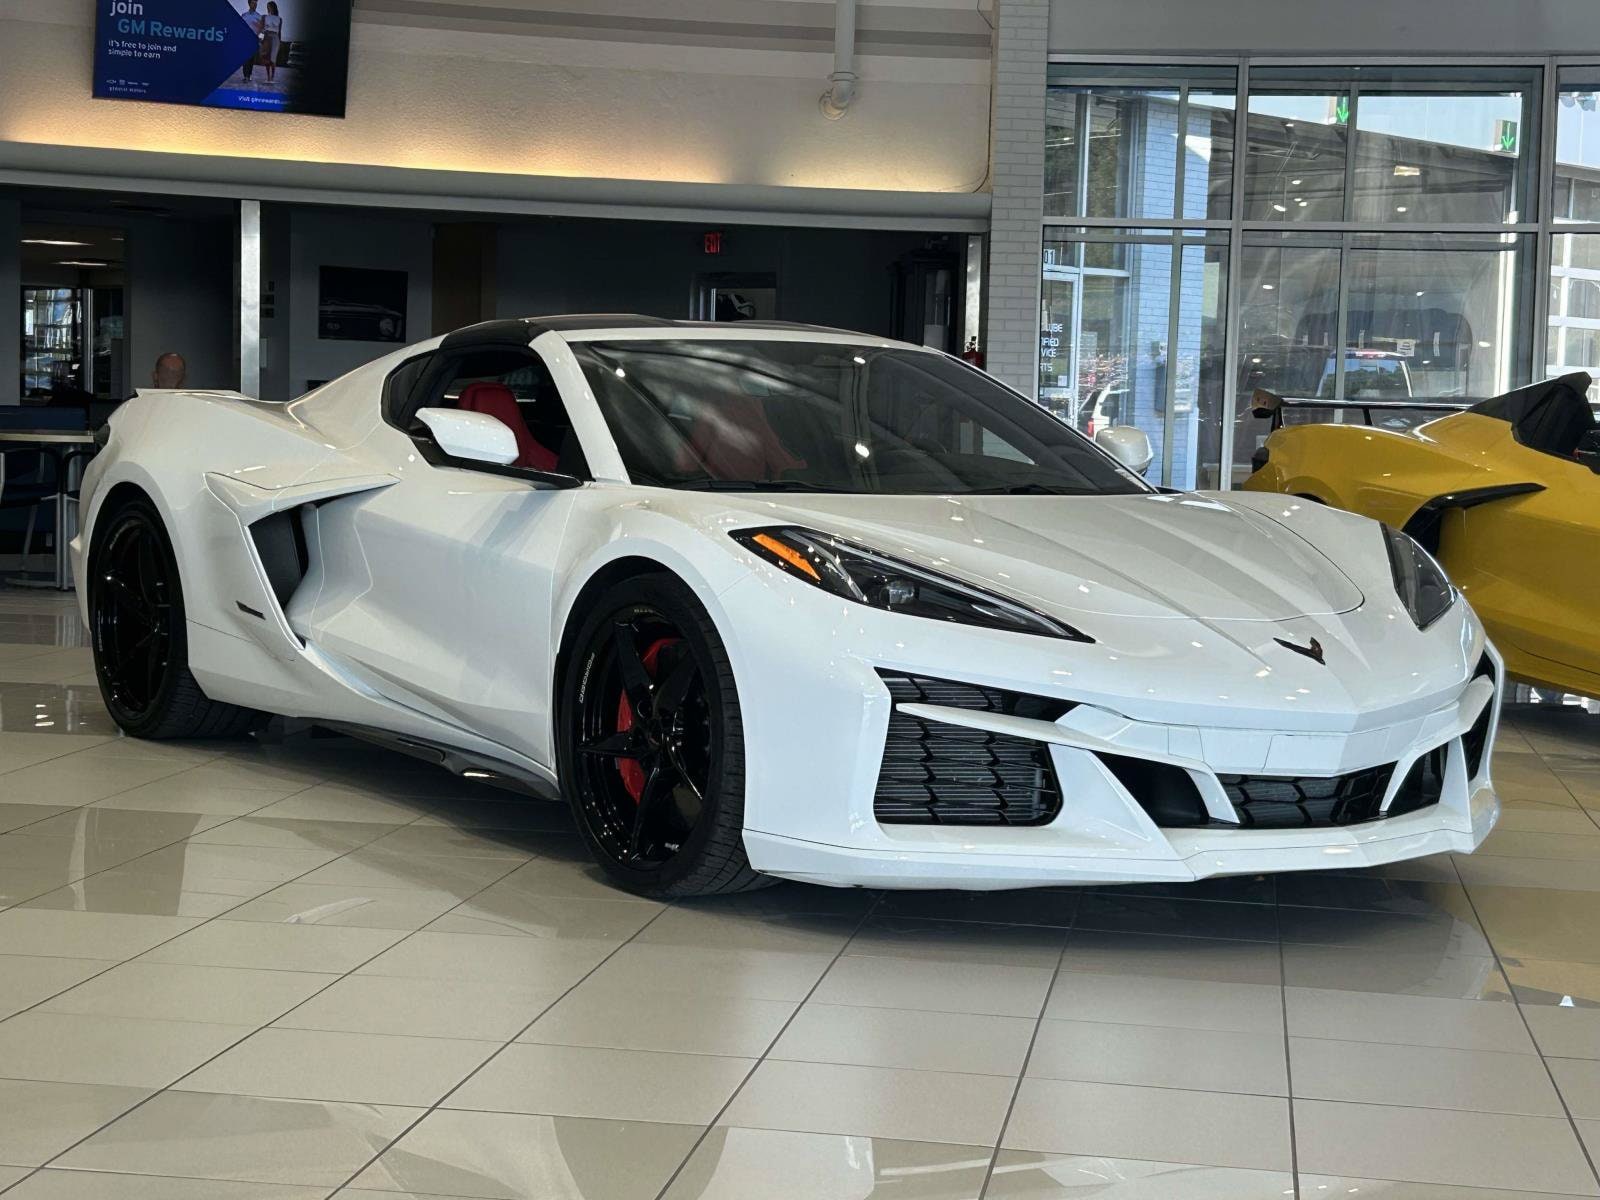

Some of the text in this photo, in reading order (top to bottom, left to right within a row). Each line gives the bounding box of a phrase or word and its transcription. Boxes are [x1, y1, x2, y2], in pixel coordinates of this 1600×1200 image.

[109, 0, 144, 17] join
[117, 19, 146, 36] GM
[108, 48, 133, 57] simple
[134, 50, 142, 58] to
[121, 40, 137, 50] free
[138, 41, 147, 50] to
[147, 42, 162, 52] join
[162, 45, 177, 53] and
